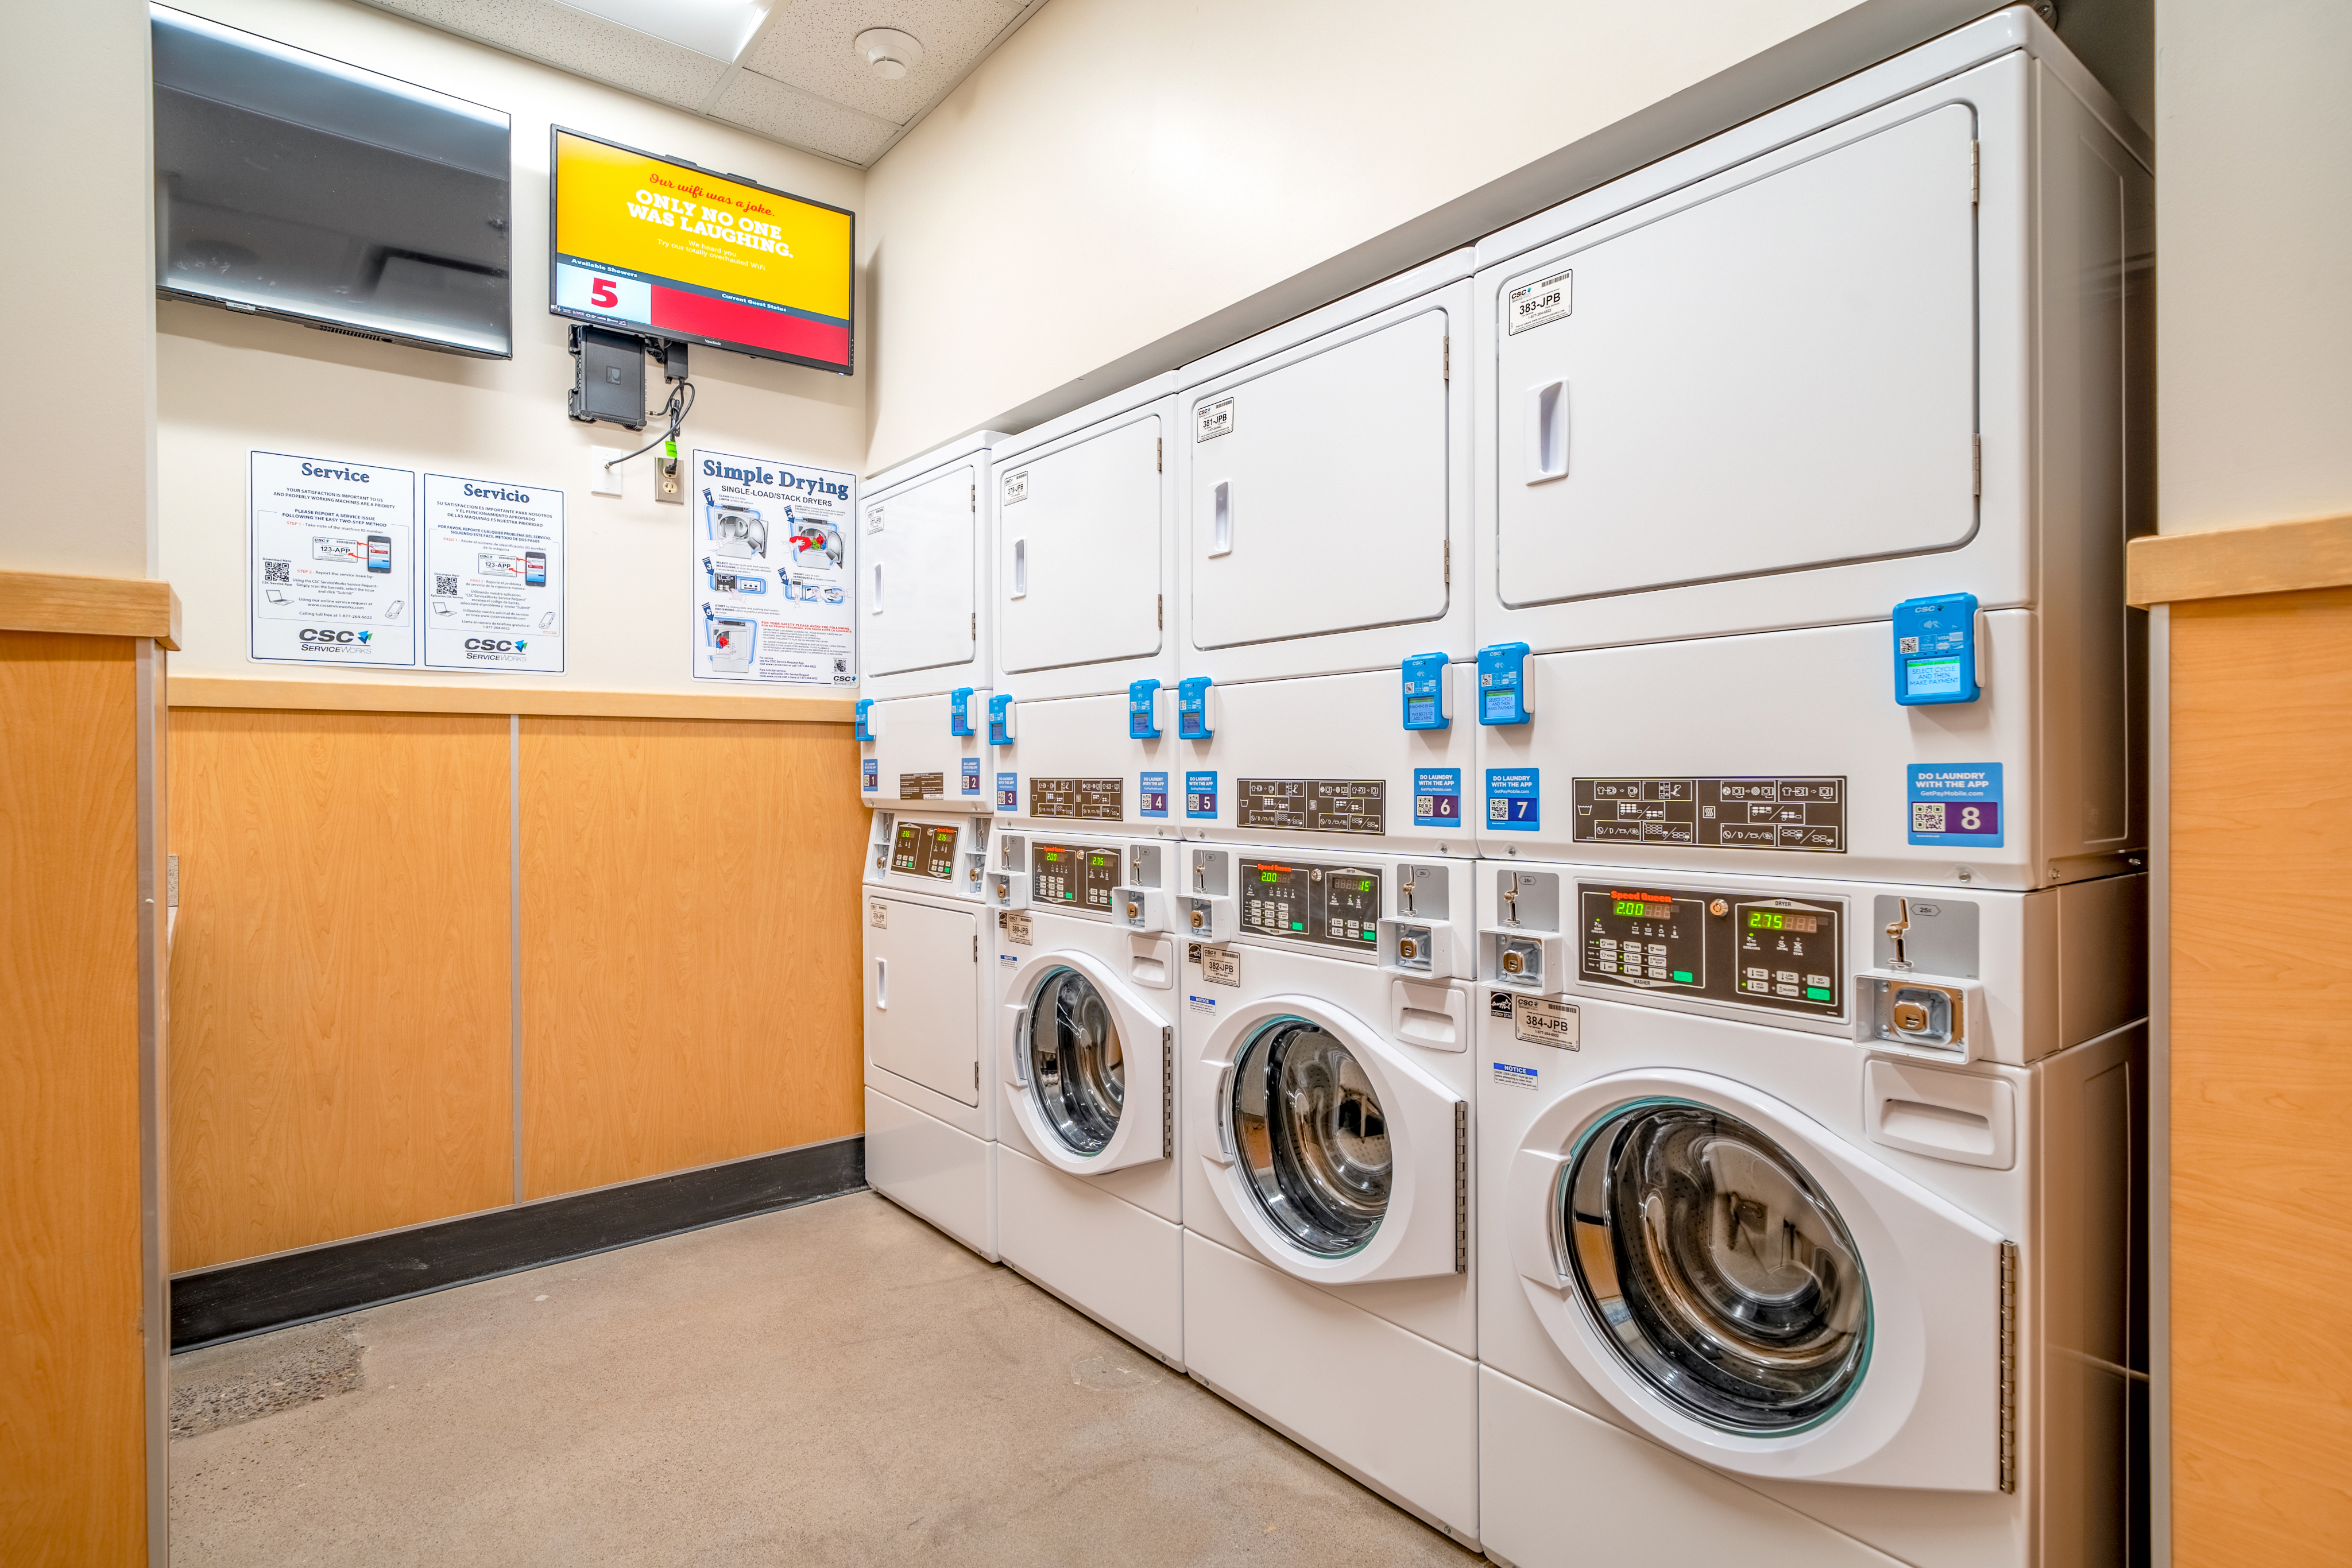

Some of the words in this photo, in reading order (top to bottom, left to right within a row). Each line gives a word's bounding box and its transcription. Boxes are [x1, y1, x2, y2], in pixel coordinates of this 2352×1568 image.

[649, 173, 675, 188] Our
[678, 184, 704, 199] wifi
[706, 192, 732, 204] was
[744, 202, 775, 216] joke.
[636, 189, 697, 216] ONLY
[701, 206, 734, 227] NO
[738, 218, 782, 241] ONE
[626, 202, 675, 227] WAS
[680, 215, 794, 258] LAUGHING.
[657, 238, 670, 247] Try
[686, 247, 708, 257] totally
[709, 253, 749, 266] overhauled
[701, 243, 722, 253] heard
[571, 258, 606, 270] Available
[608, 267, 638, 278] Showers
[591, 277, 618, 308] 5
[1511, 289, 1526, 299] CSC
[722, 293, 746, 303] Current
[748, 300, 766, 308] Guest
[767, 304, 787, 312] Status
[1519, 292, 1561, 315] 383-JPB
[1203, 413, 1227, 428] 381-JPB
[301, 462, 369, 483] Service
[703, 459, 773, 486] Simple
[779, 471, 849, 500] Drying
[464, 483, 529, 503] Servicio
[721, 485, 800, 503] SINGLE-LOAD/STACK
[803, 497, 832, 506] DRYERS
[1008, 484, 1024, 494] 379-JPB
[299, 629, 354, 643] CSC
[465, 638, 512, 651] CSC
[872, 776, 875, 785] 1
[972, 777, 976, 788] 2
[1008, 793, 1012, 804] 3
[1156, 796, 1162, 808] 4
[1204, 796, 1210, 810] 5
[1440, 799, 1450, 815] 6
[1517, 802, 1528, 818] 7
[1961, 807, 1980, 830] 8
[1047, 853, 1057, 861] 2.00
[1092, 857, 1104, 866] 2.75
[1261, 872, 1277, 882] 2.00
[1610, 890, 1641, 902] Speed
[1641, 892, 1673, 904] Queen
[1616, 901, 1644, 916] 2.00
[1750, 913, 1782, 928] 2.75
[1012, 926, 1028, 934] 380-JPB
[1209, 962, 1233, 973] 382-JPB
[1526, 1015, 1568, 1031] 384-JPB
[1504, 1065, 1527, 1074] NOTICE
